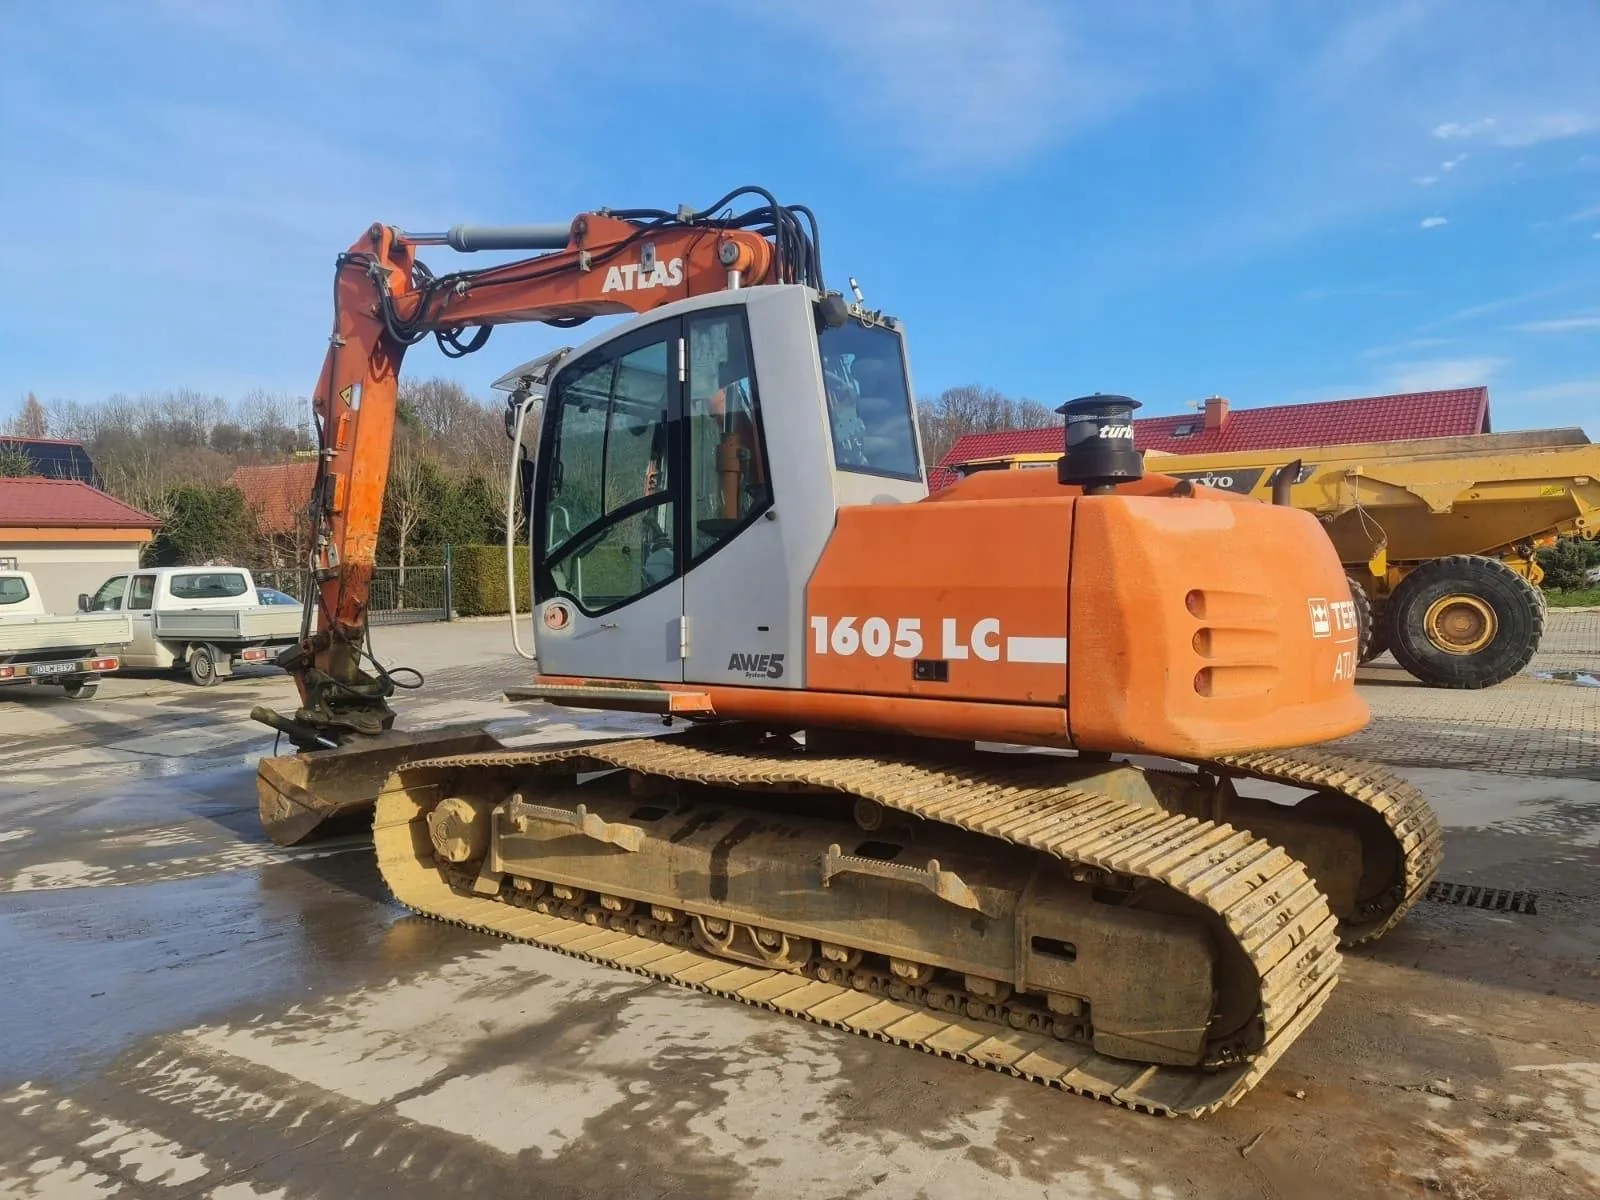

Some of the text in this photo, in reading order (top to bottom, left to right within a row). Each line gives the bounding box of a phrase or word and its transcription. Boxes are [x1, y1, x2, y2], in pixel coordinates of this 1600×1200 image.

[602, 258, 683, 293] ATLAS
[1100, 425, 1134, 439] turb
[811, 616, 1000, 662] 1605 LC
